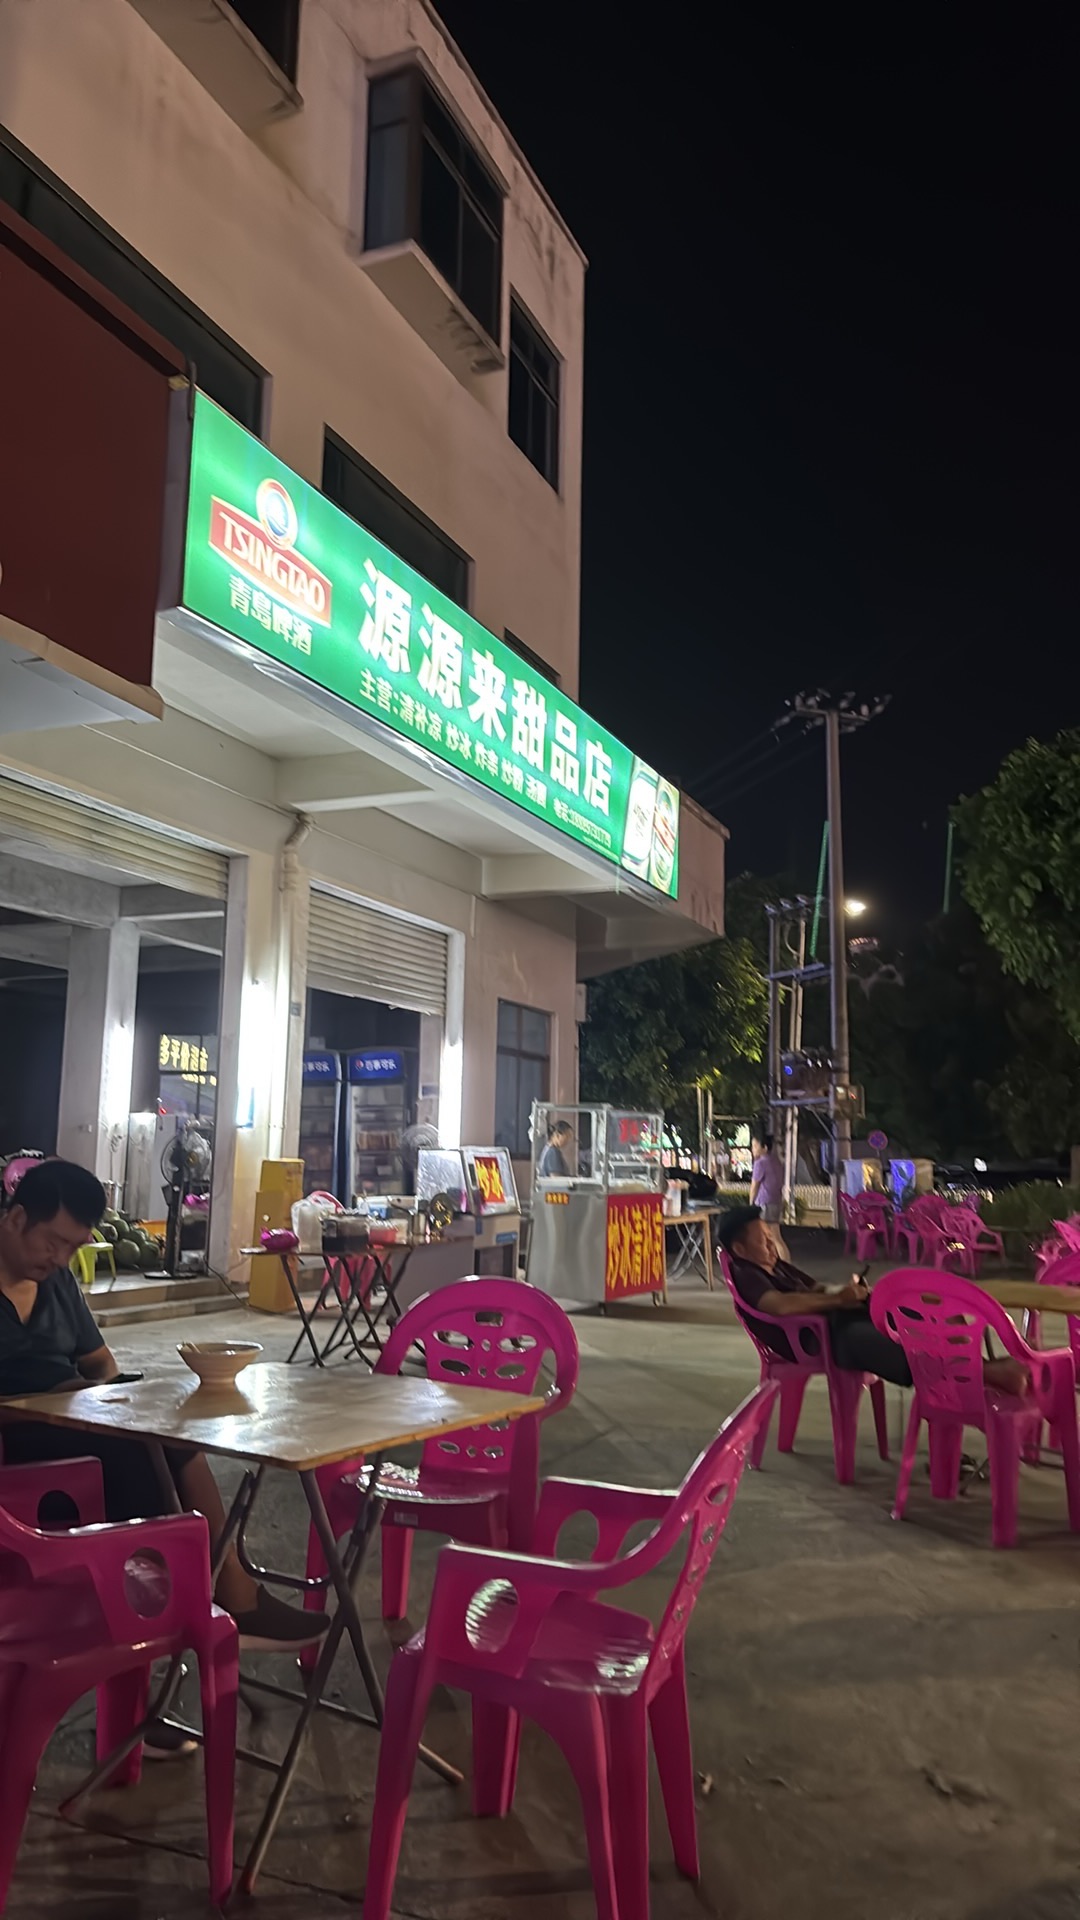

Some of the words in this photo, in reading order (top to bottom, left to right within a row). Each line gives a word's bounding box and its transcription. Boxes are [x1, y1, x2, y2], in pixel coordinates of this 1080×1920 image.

[219, 511, 326, 613] TSINGTAO
[357, 557, 614, 818] 源源来甜品店
[475, 1159, 504, 1200] 炒冰
